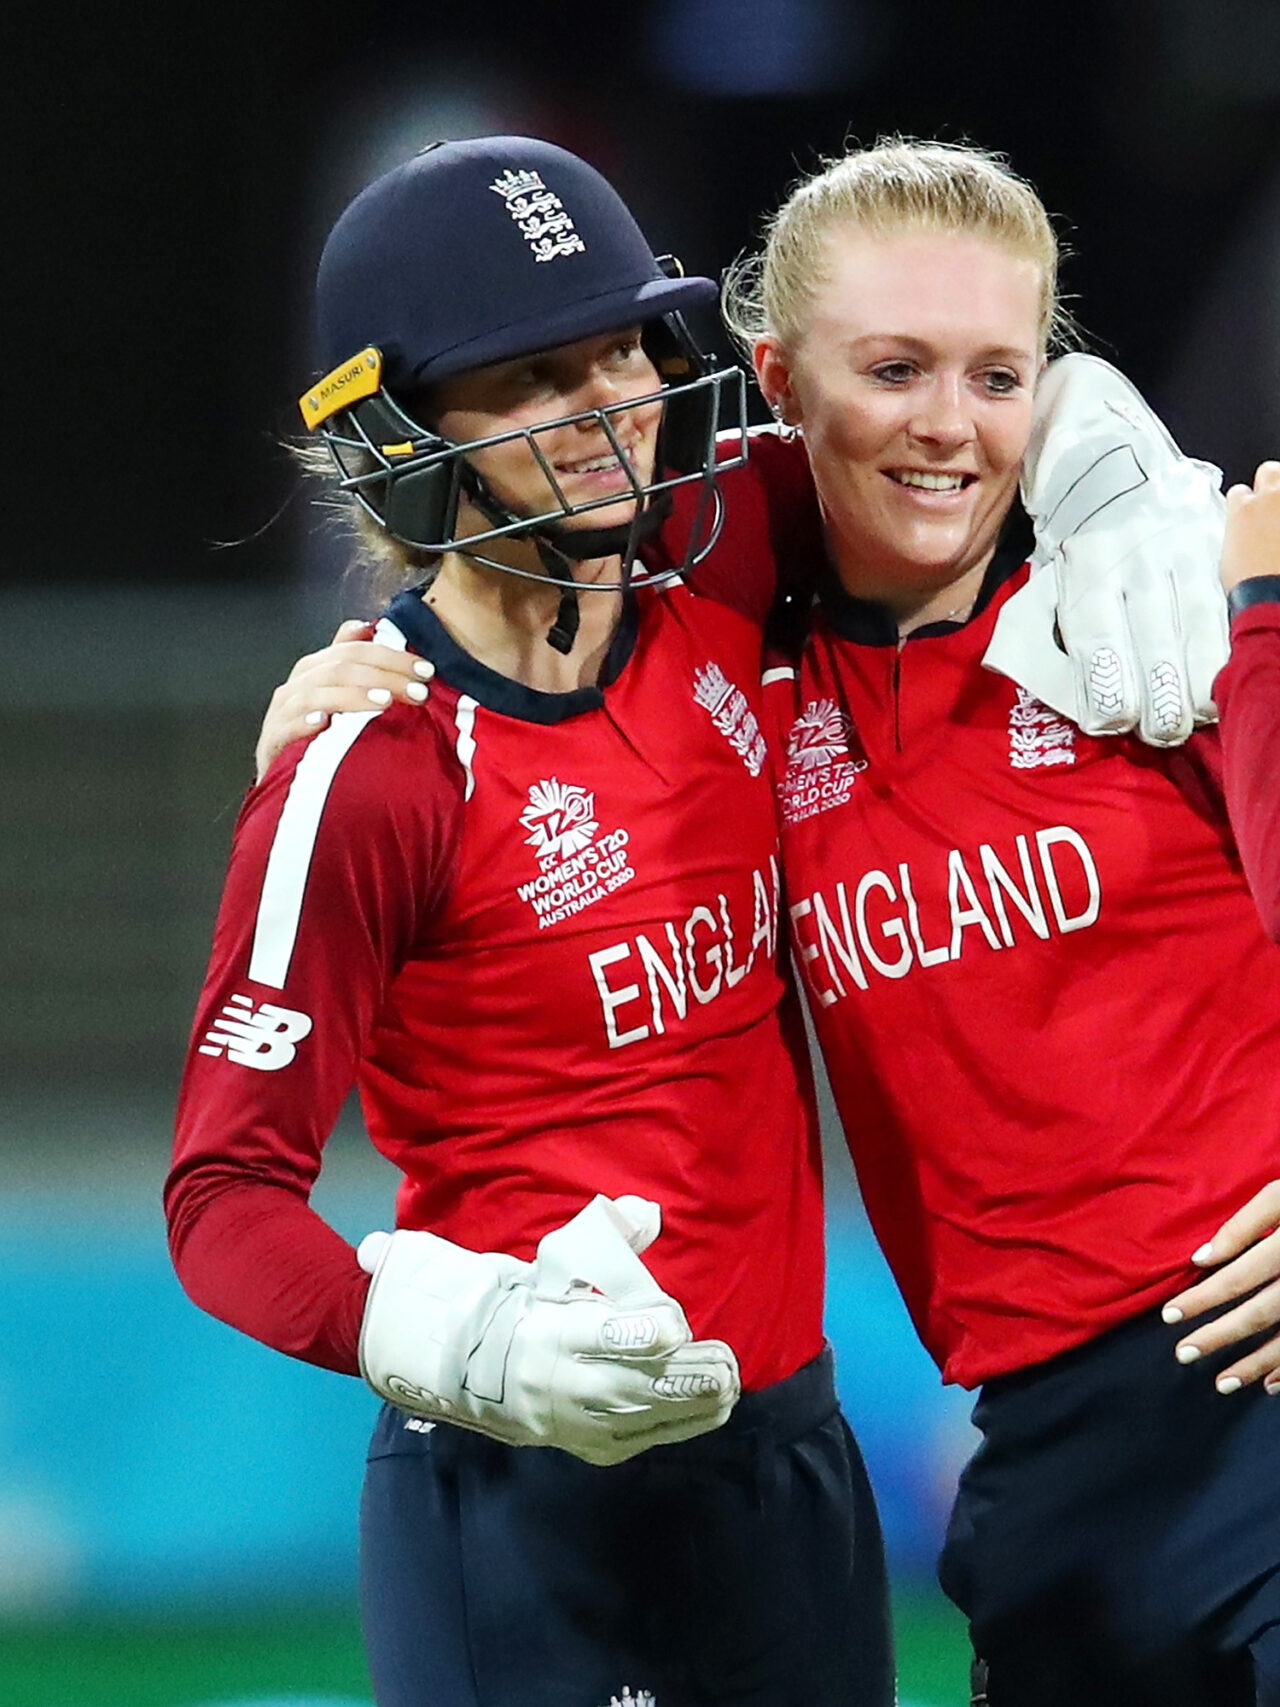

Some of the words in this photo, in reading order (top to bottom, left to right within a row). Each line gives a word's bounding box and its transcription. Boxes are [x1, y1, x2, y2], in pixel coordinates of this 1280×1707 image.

[320, 364, 363, 400] MASURI
[777, 767, 831, 798] OMEN'S
[833, 760, 868, 779] T20
[783, 787, 819, 814] ORLD
[821, 776, 854, 798] CUP
[821, 793, 851, 811] 2020
[517, 848, 600, 901] WOMEN'S
[596, 829, 629, 856] T20
[532, 870, 597, 915] WORLD
[596, 850, 627, 879] CUP
[539, 885, 607, 929] AUSTRALIA
[605, 867, 635, 891] 2020
[790, 825, 1102, 1008] ENGLAND
